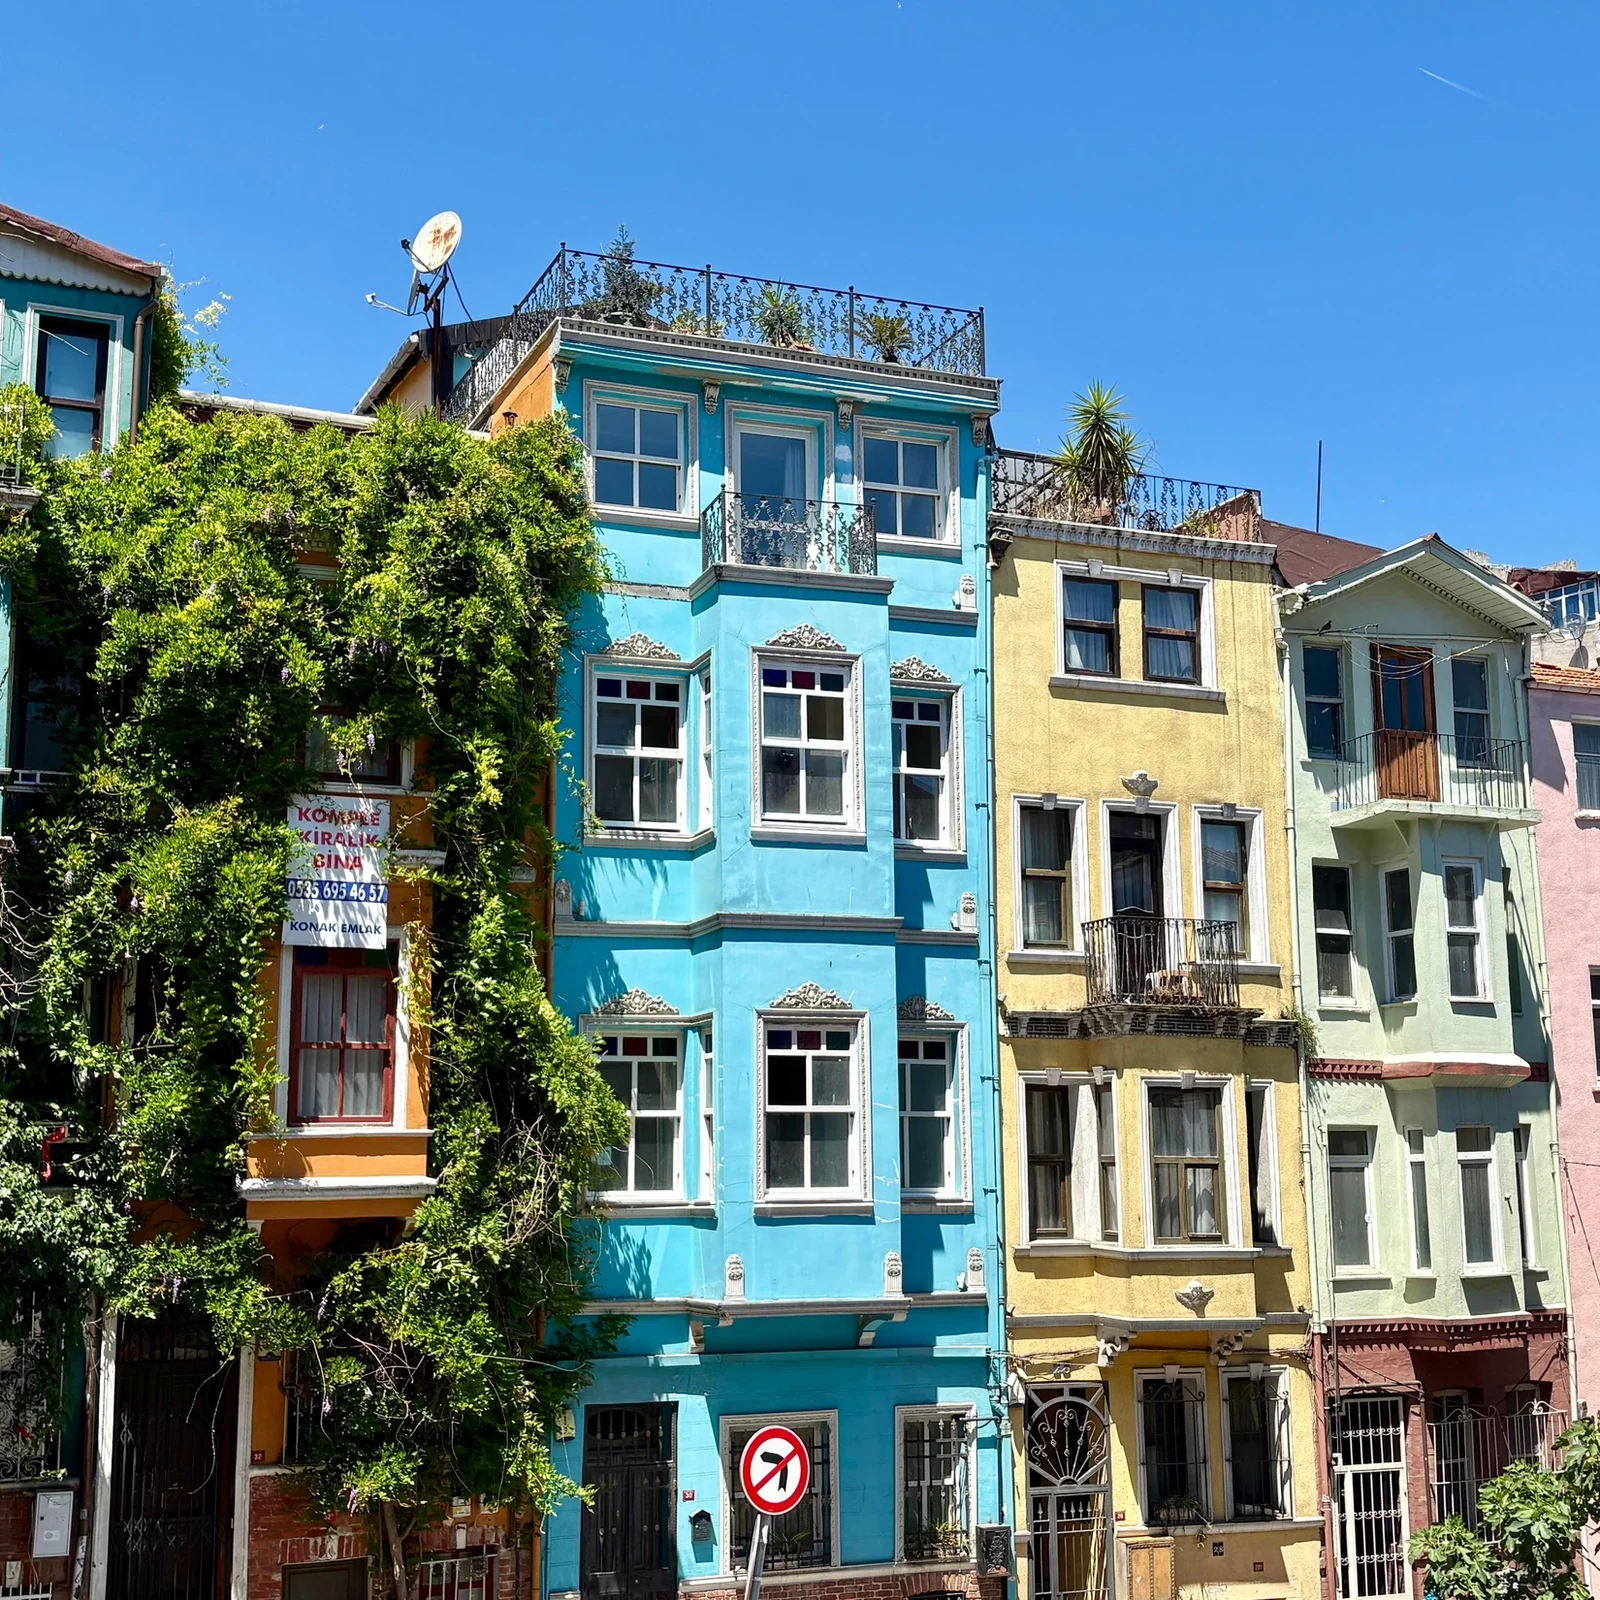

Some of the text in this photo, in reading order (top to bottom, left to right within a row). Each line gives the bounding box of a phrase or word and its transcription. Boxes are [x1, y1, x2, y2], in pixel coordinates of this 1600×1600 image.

[298, 807, 380, 826] KOMPLE
[313, 849, 364, 870] BİNA
[288, 880, 385, 902] 0535 695 46 57
[290, 921, 381, 935] KONAK EMLAK
